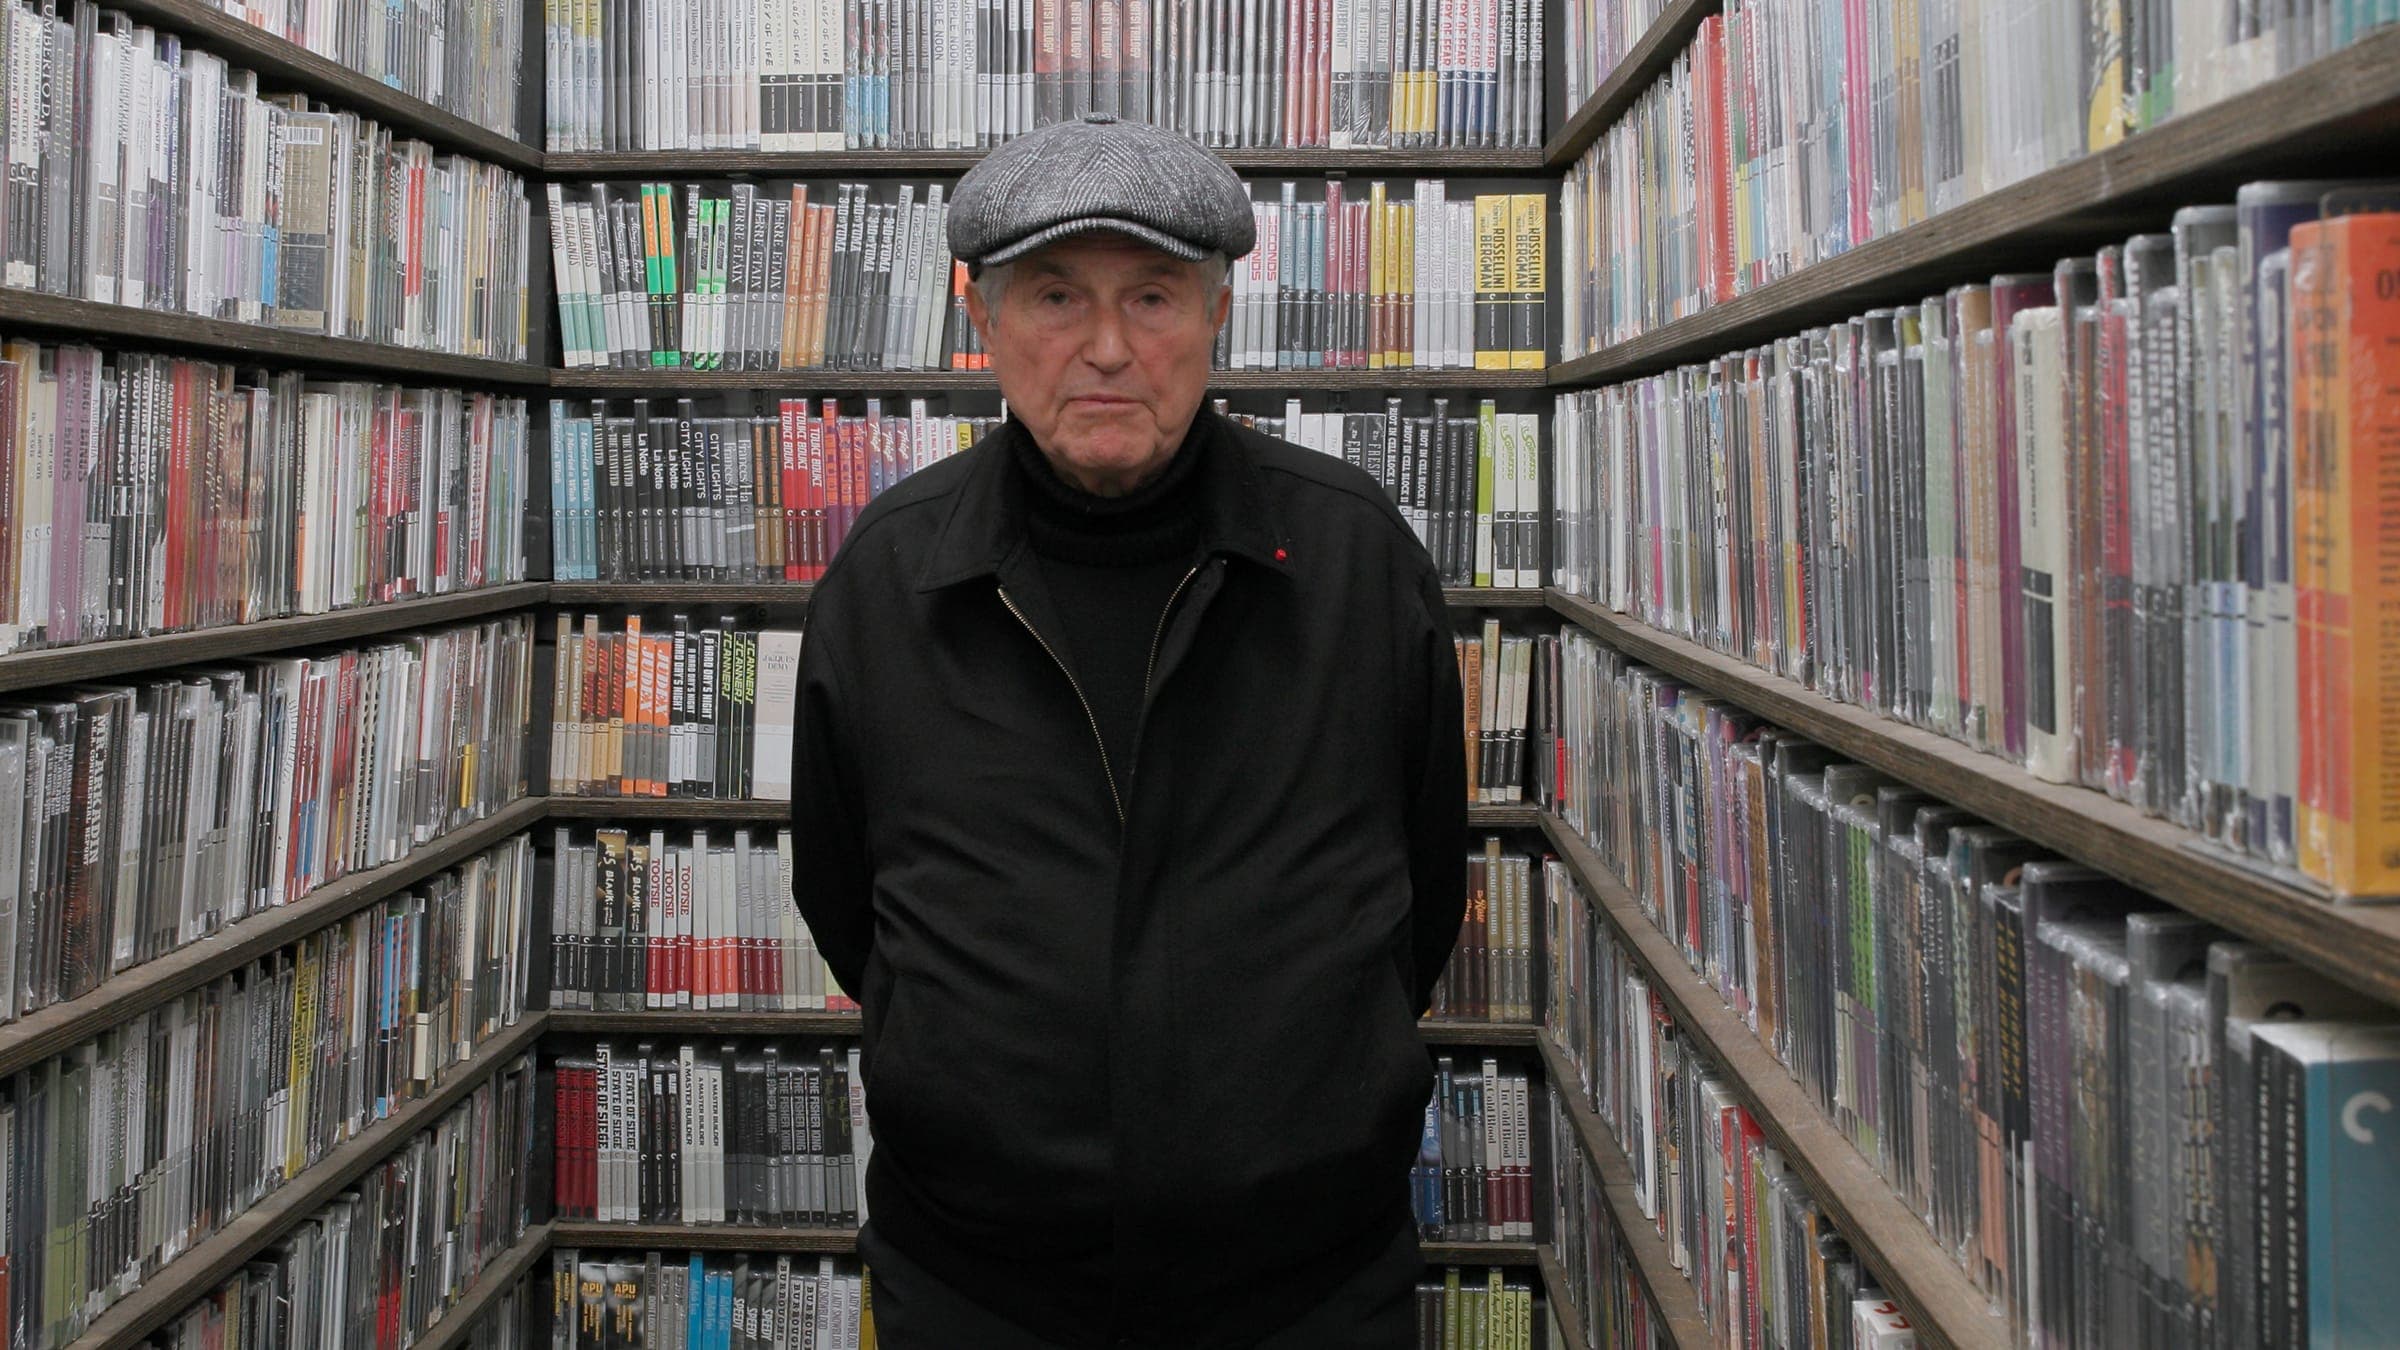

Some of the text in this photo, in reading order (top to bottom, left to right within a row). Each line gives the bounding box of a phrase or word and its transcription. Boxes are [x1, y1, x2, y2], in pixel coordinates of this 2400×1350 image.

[690, 9, 699, 36] Bloody
[1043, 22, 1053, 53] TRILOGY
[1071, 27, 1082, 58] TRILOGY
[1102, 26, 1112, 58] TRILOGY
[1130, 26, 1140, 57] TRILOGY
[1377, 12, 1389, 63] WATERFRONT
[42, 4, 52, 118] UMBERTO D.
[935, 31, 944, 60] NOON
[950, 36, 958, 66] NOON
[965, 40, 974, 70] NOON
[64, 52, 73, 140] UMBERTO
[732, 196, 745, 283] PIERRE ETAIX
[771, 203, 786, 288] PIERRE ETAIX
[835, 223, 848, 252] YUMA
[850, 223, 862, 252] YUMA
[895, 195, 907, 260] medium cool
[924, 195, 938, 265] LIFE IS SWEET
[864, 243, 877, 272] YUMA
[879, 243, 892, 272] YUMA
[908, 216, 920, 280] medium cool
[1268, 216, 1276, 281] SECONDS
[1481, 228, 1504, 288] ROSSELLINI BERGMAN
[1516, 228, 1540, 288] ROSSELLINI BERGMAN
[751, 251, 764, 288] ETAIX
[936, 256, 946, 288] SWEET
[2161, 317, 2173, 399] HIGH
[140, 367, 148, 435] FIGHTING
[1390, 408, 1398, 425] RIOT
[117, 368, 127, 484] YOUTH BEAST
[608, 433, 617, 448] THE
[623, 433, 632, 448] THE
[782, 411, 794, 470] TOUKI BOUKI
[796, 411, 807, 470] TOUKI BOUKI
[870, 422, 880, 452] Thief
[898, 430, 909, 460] Thief
[1388, 437, 1396, 454] CELL
[1389, 428, 1397, 436] IN
[1420, 430, 1428, 446] RIOT
[638, 433, 648, 475] La Notte
[680, 421, 691, 488] CITY LIGHTS
[694, 432, 705, 499] CITY LIGHTS
[710, 433, 721, 500] CITY LIGHTS
[810, 428, 822, 487] TOUKI BOUKI
[883, 432, 895, 462] Thief
[1368, 444, 1381, 480] FRESH
[1388, 455, 1396, 477] BLOCK
[1420, 450, 1427, 458] IN
[669, 449, 678, 489] La Notte
[724, 443, 737, 504] Frances Ha
[738, 439, 750, 502] Frances Ha
[1418, 477, 1426, 496] BLOCK
[674, 638, 684, 660] HARD
[687, 655, 696, 671] HARD
[704, 646, 713, 667] HARD
[722, 630, 732, 700] SCANNERS
[613, 644, 624, 712] RED RIVER
[640, 646, 653, 713] JUDEX
[656, 650, 668, 718] JUDEX
[674, 662, 684, 685] DAY'S
[687, 673, 695, 692] DAY'S
[703, 669, 713, 692] DAY'S
[734, 640, 743, 704] SCANNERS
[746, 640, 755, 704] SCANNERS
[673, 687, 683, 711] NIGHT
[687, 694, 695, 713] NIGHT
[702, 694, 712, 719] NIGHT
[88, 714, 107, 864] MR. ARKADIN
[83, 828, 93, 865] REPORT
[604, 844, 615, 905] LES BLANK:
[631, 850, 642, 911] LES BLANK:
[651, 859, 660, 907] TOOTSIE
[665, 869, 674, 918] TOOTSIE
[681, 866, 691, 915] TOOTSIE
[1475, 899, 1487, 923] Rose
[597, 1052, 608, 1149] STATE OF SIEGE
[626, 1072, 636, 1150] STATE OF SIEGE
[779, 1077, 790, 1150] THE FISHER KING
[794, 1077, 806, 1150] THE FISHER KING
[810, 1077, 821, 1150] THE FISHER KING
[1486, 1075, 1496, 1144] In Cold Blood
[1516, 1090, 1526, 1158] In Cold Blood
[2286, 1104, 2296, 1308] INFERNAL AFFAIRS
[614, 1284, 636, 1294] APU
[820, 1274, 829, 1290] LADY
[733, 1298, 744, 1330] SPEEDY
[746, 1307, 757, 1340] SPEEDY
[761, 1308, 773, 1341] SPEEDY
